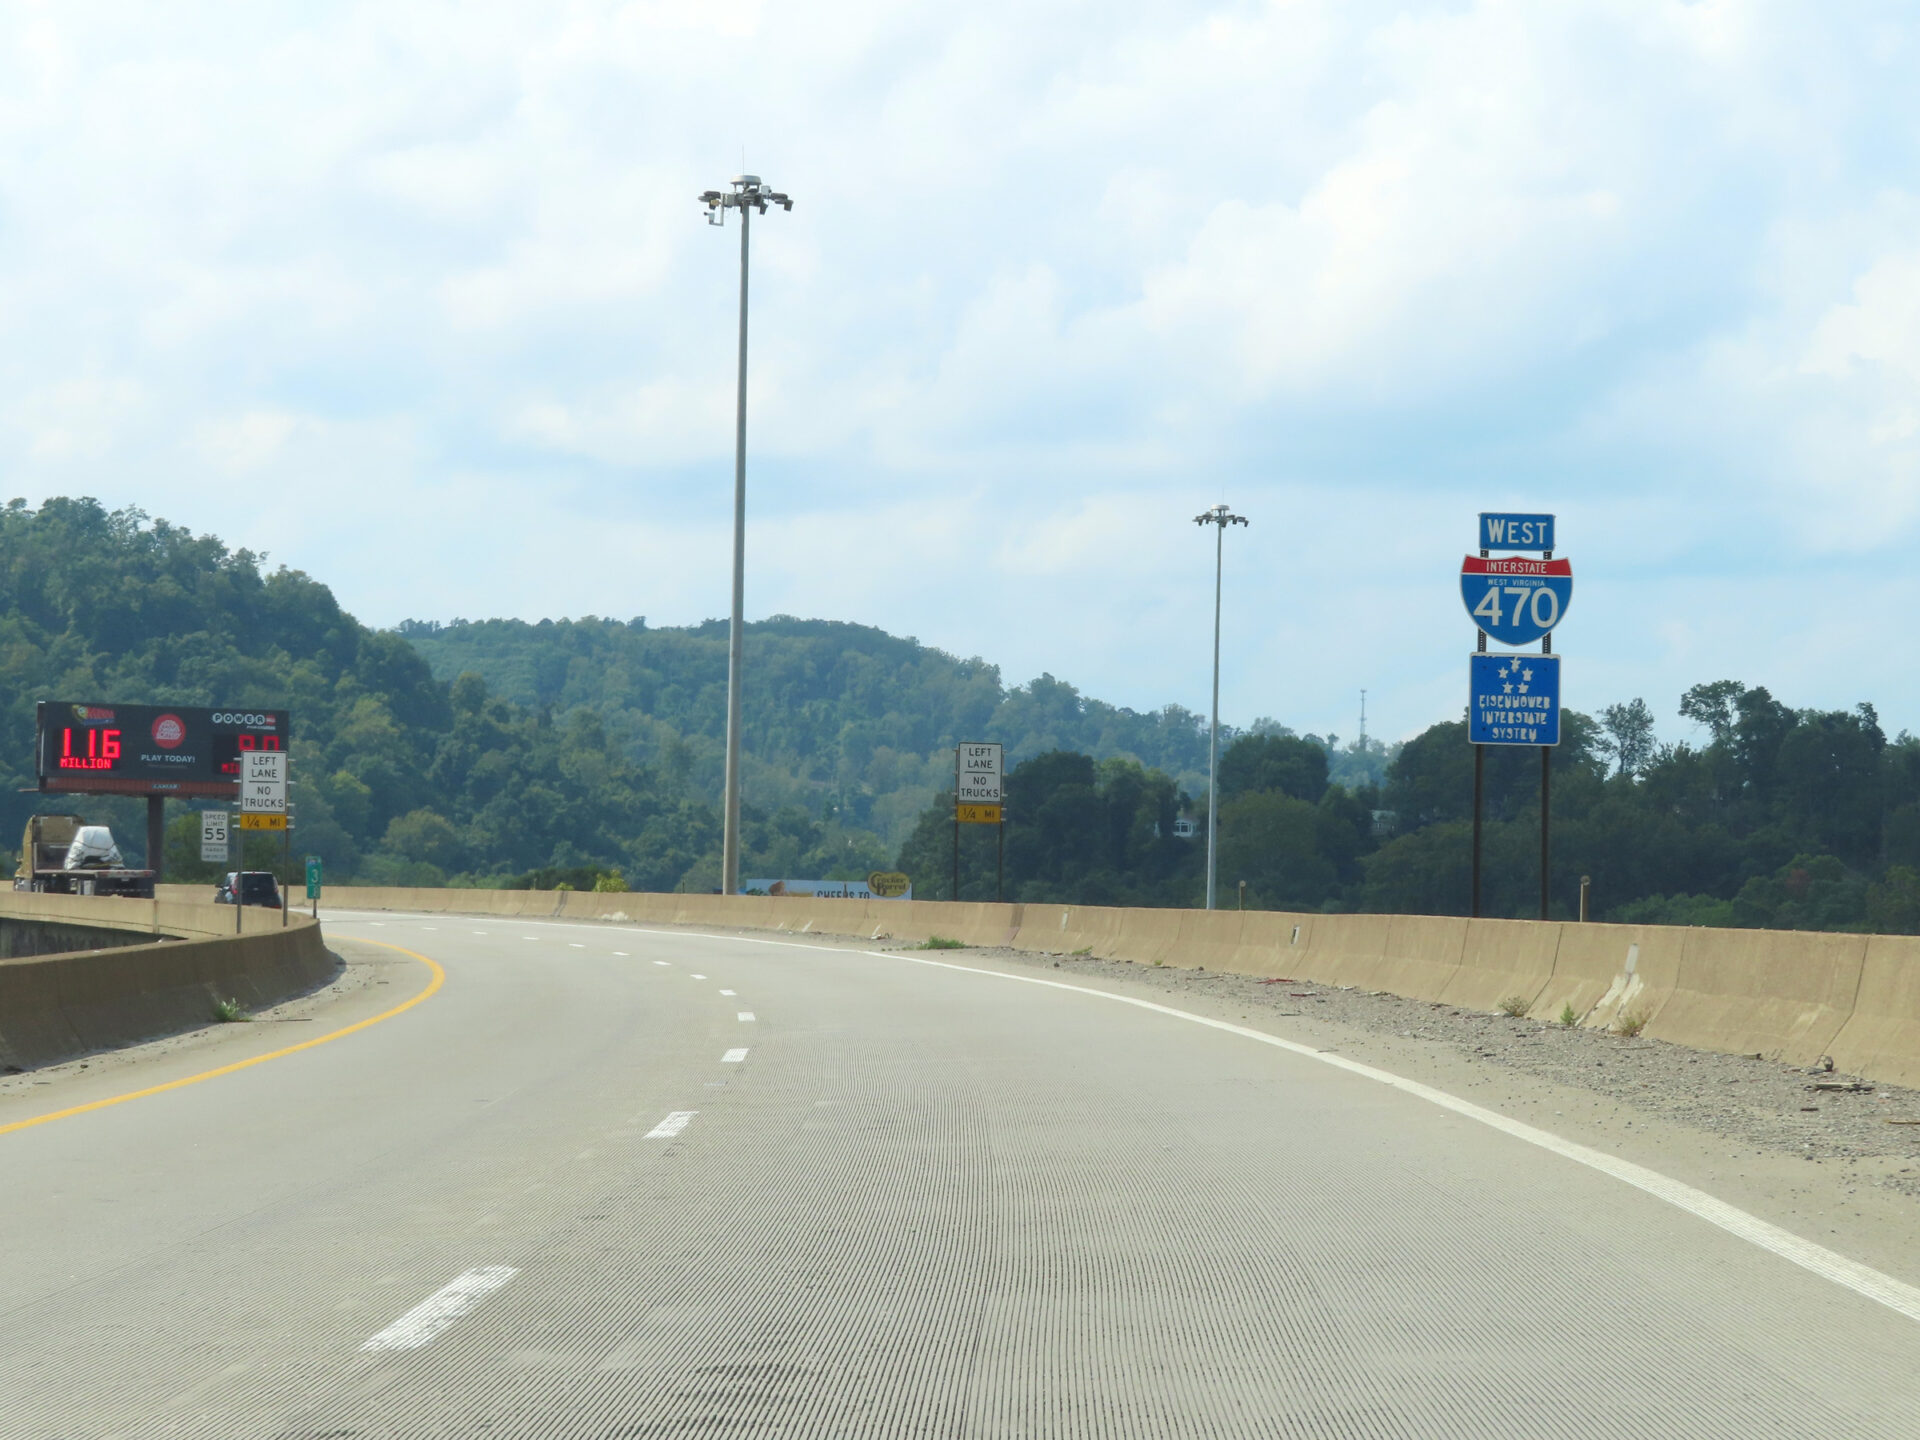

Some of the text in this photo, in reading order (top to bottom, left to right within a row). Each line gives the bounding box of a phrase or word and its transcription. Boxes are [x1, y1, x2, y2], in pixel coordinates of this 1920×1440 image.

[1487, 519, 1547, 544] WEST
[1486, 561, 1547, 574] INTERSTATE
[1488, 578, 1545, 587] WEST VIRGINIA
[1473, 586, 1559, 628] 470
[1479, 694, 1550, 710] EISENHOWER
[1481, 711, 1547, 725] INTERSTATE
[1492, 727, 1537, 743] SYSTEM
[64, 728, 121, 759] 116
[968, 747, 992, 757] LEFT
[60, 757, 112, 769] MILLION
[141, 754, 195, 764] PLAY TODAY!
[252, 756, 277, 766] LEFT
[967, 759, 993, 769] LANE
[251, 769, 278, 778] LANE
[973, 776, 987, 786] NO
[257, 786, 271, 795] NO
[961, 788, 999, 798] TRUCKS
[244, 798, 284, 808] TRUCKS
[984, 810, 995, 818] MI
[269, 818, 280, 827] MI
[204, 828, 226, 841] 55
[311, 868, 319, 883] 3
